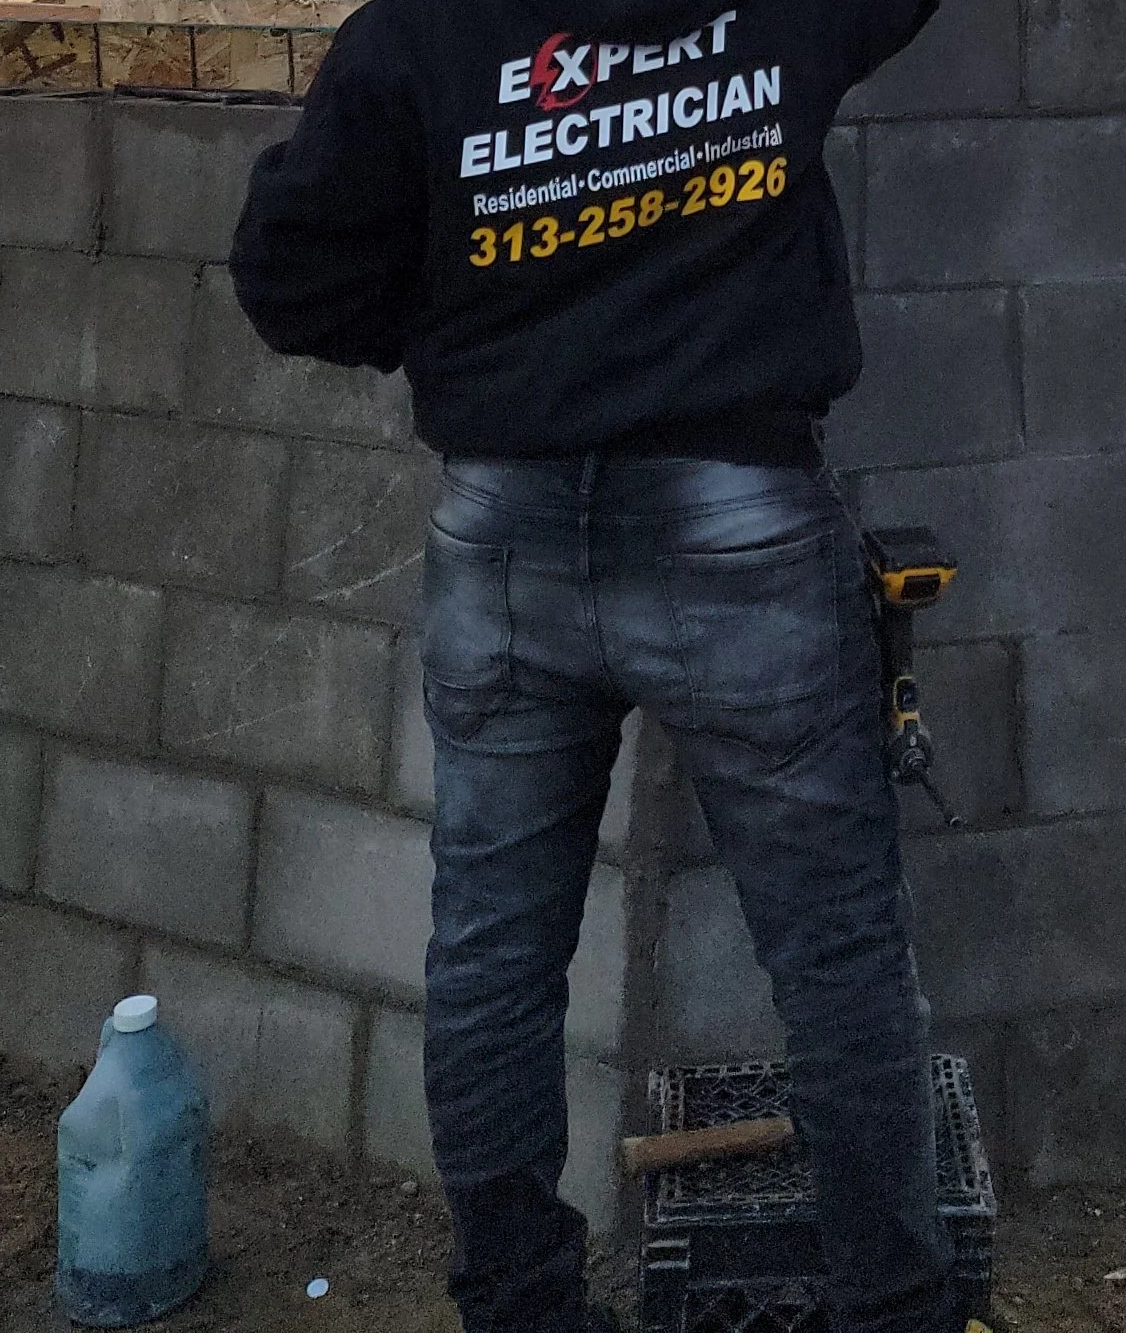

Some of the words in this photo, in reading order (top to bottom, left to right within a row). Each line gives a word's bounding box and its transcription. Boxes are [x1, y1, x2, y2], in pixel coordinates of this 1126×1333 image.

[499, 10, 737, 104] EXPERT
[459, 66, 781, 178] ELECTRICIAN
[469, 157, 788, 267] 313-258-2926
